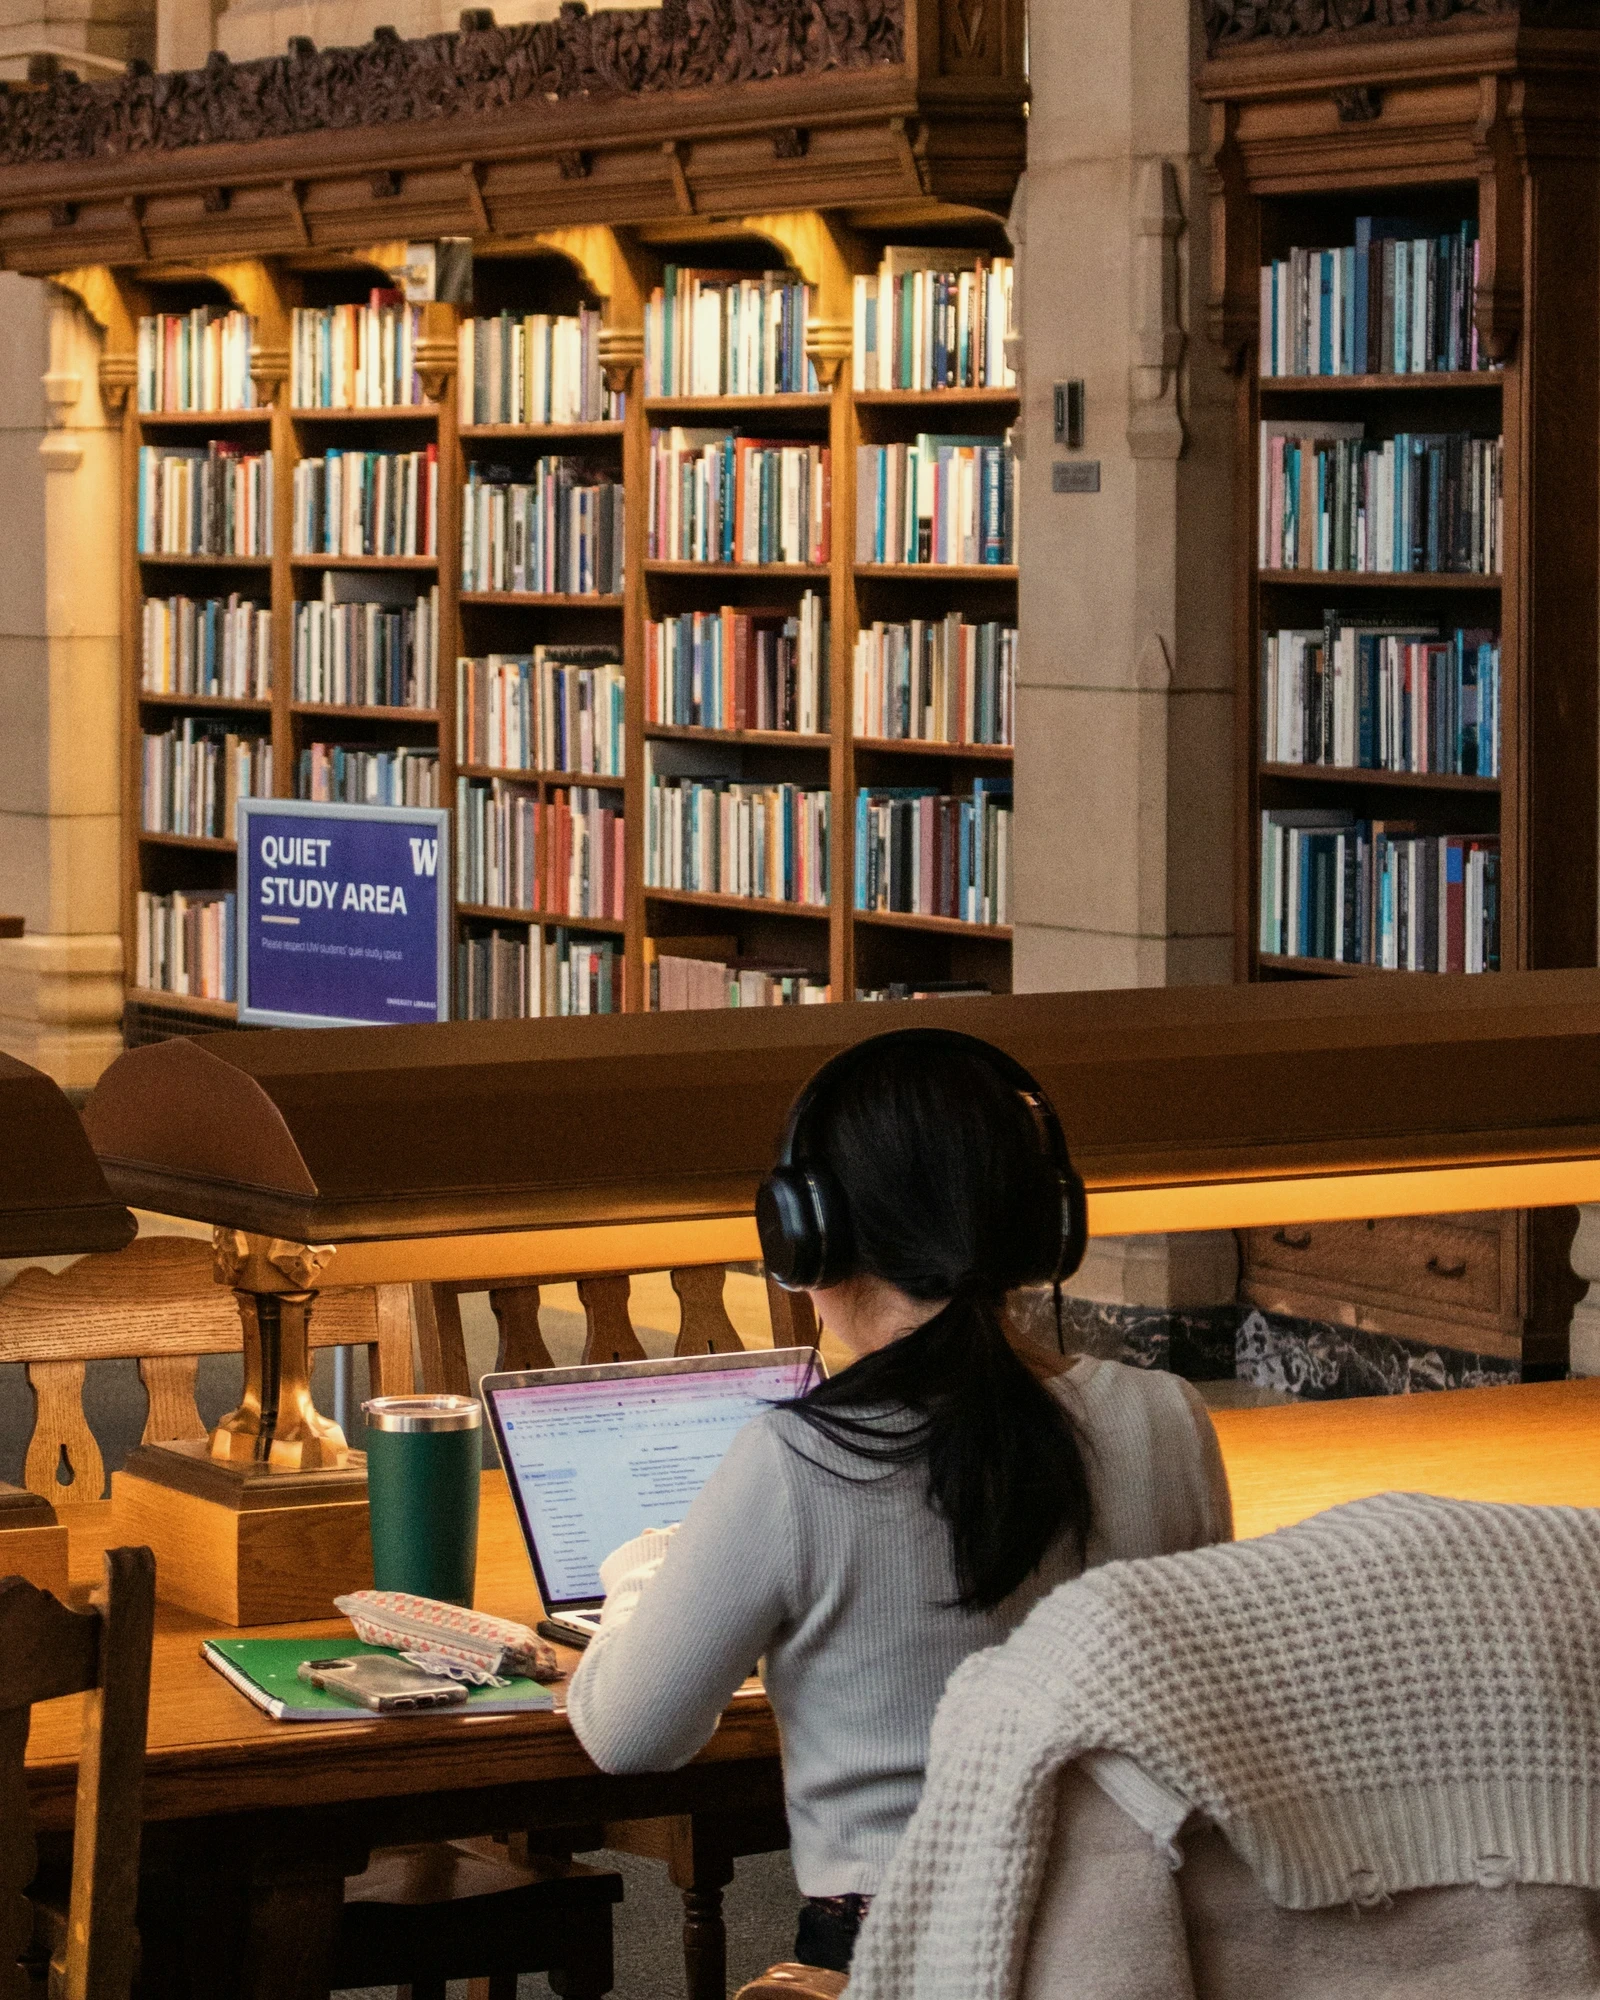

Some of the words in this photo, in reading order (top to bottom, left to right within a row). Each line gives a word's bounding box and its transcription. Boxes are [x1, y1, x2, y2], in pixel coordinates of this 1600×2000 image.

[261, 835, 331, 868] QUIET
[409, 838, 438, 877] W
[261, 876, 338, 909] STUDY
[342, 883, 408, 915] AREA
[306, 942, 319, 952] UW
[364, 948, 382, 960] study
